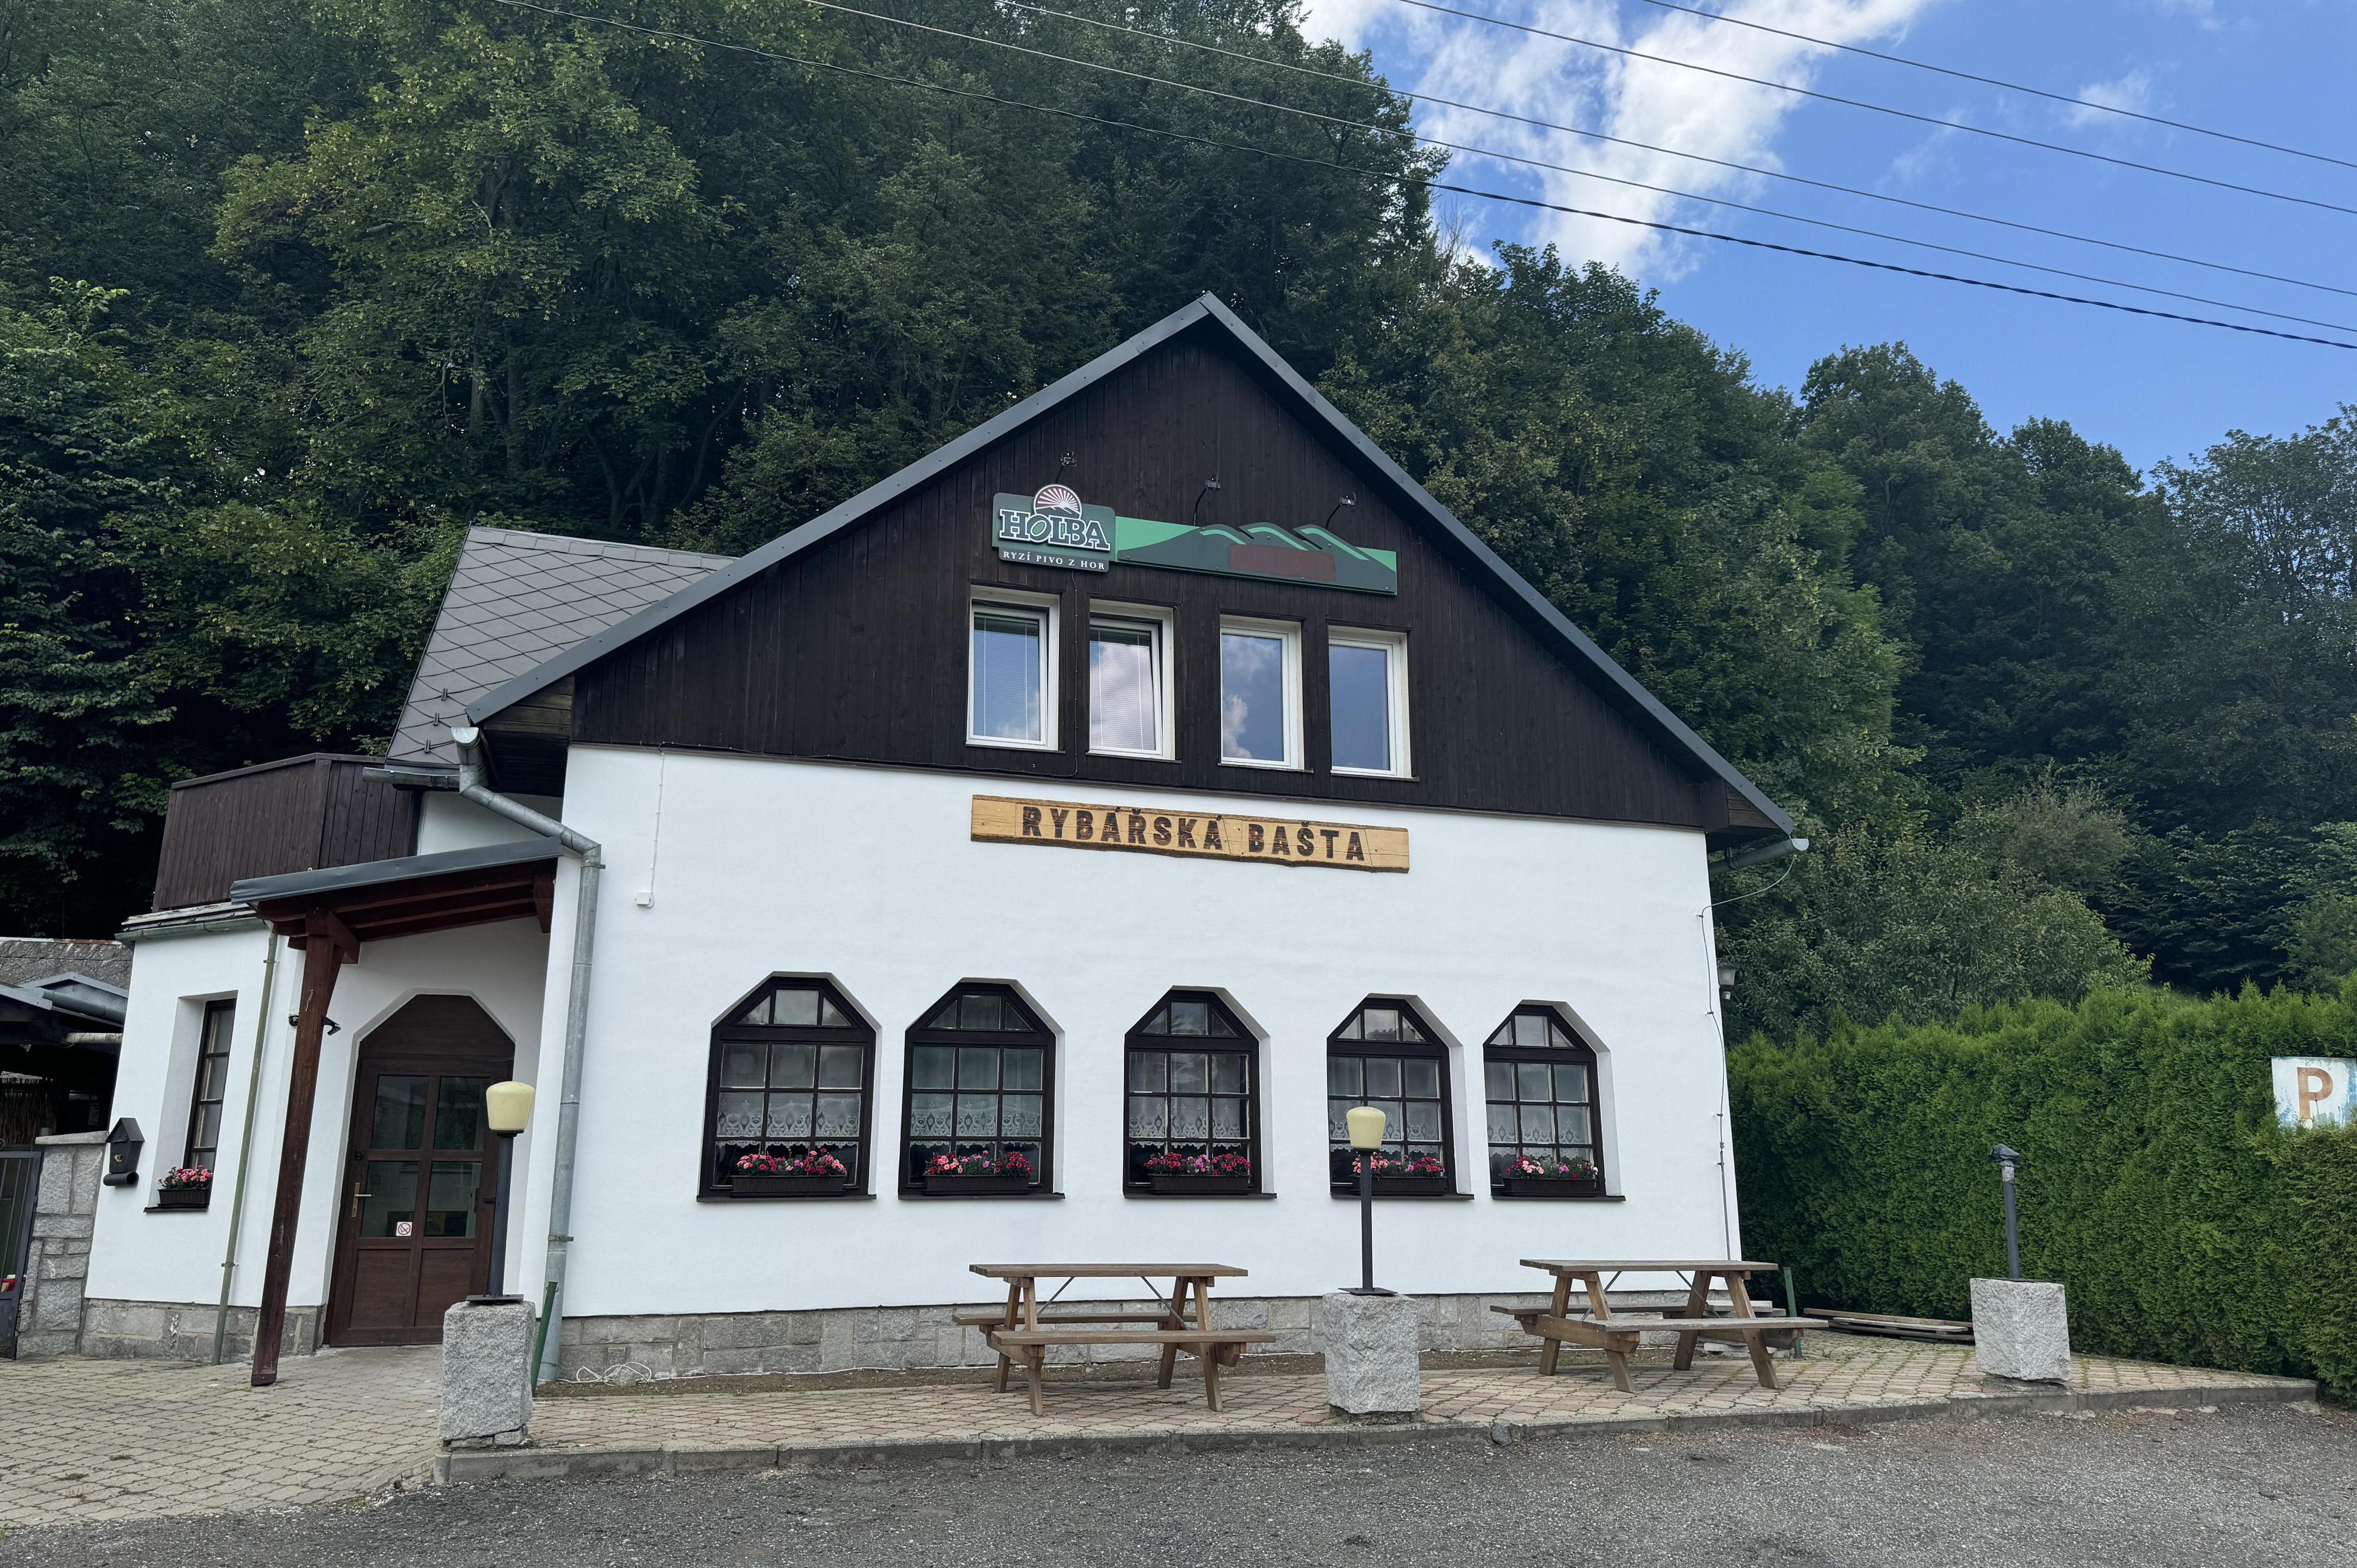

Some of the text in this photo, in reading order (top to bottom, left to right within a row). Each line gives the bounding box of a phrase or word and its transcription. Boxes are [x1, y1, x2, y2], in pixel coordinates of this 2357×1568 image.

[999, 509, 1111, 551] HOLBA
[1003, 551, 1031, 561] RYZÍ
[1036, 555, 1063, 565] PIVO
[1081, 560, 1105, 570] HOR
[1022, 806, 1365, 861] RYBÁŘSKÁ BAŠTA
[2297, 1067, 2333, 1120] P
